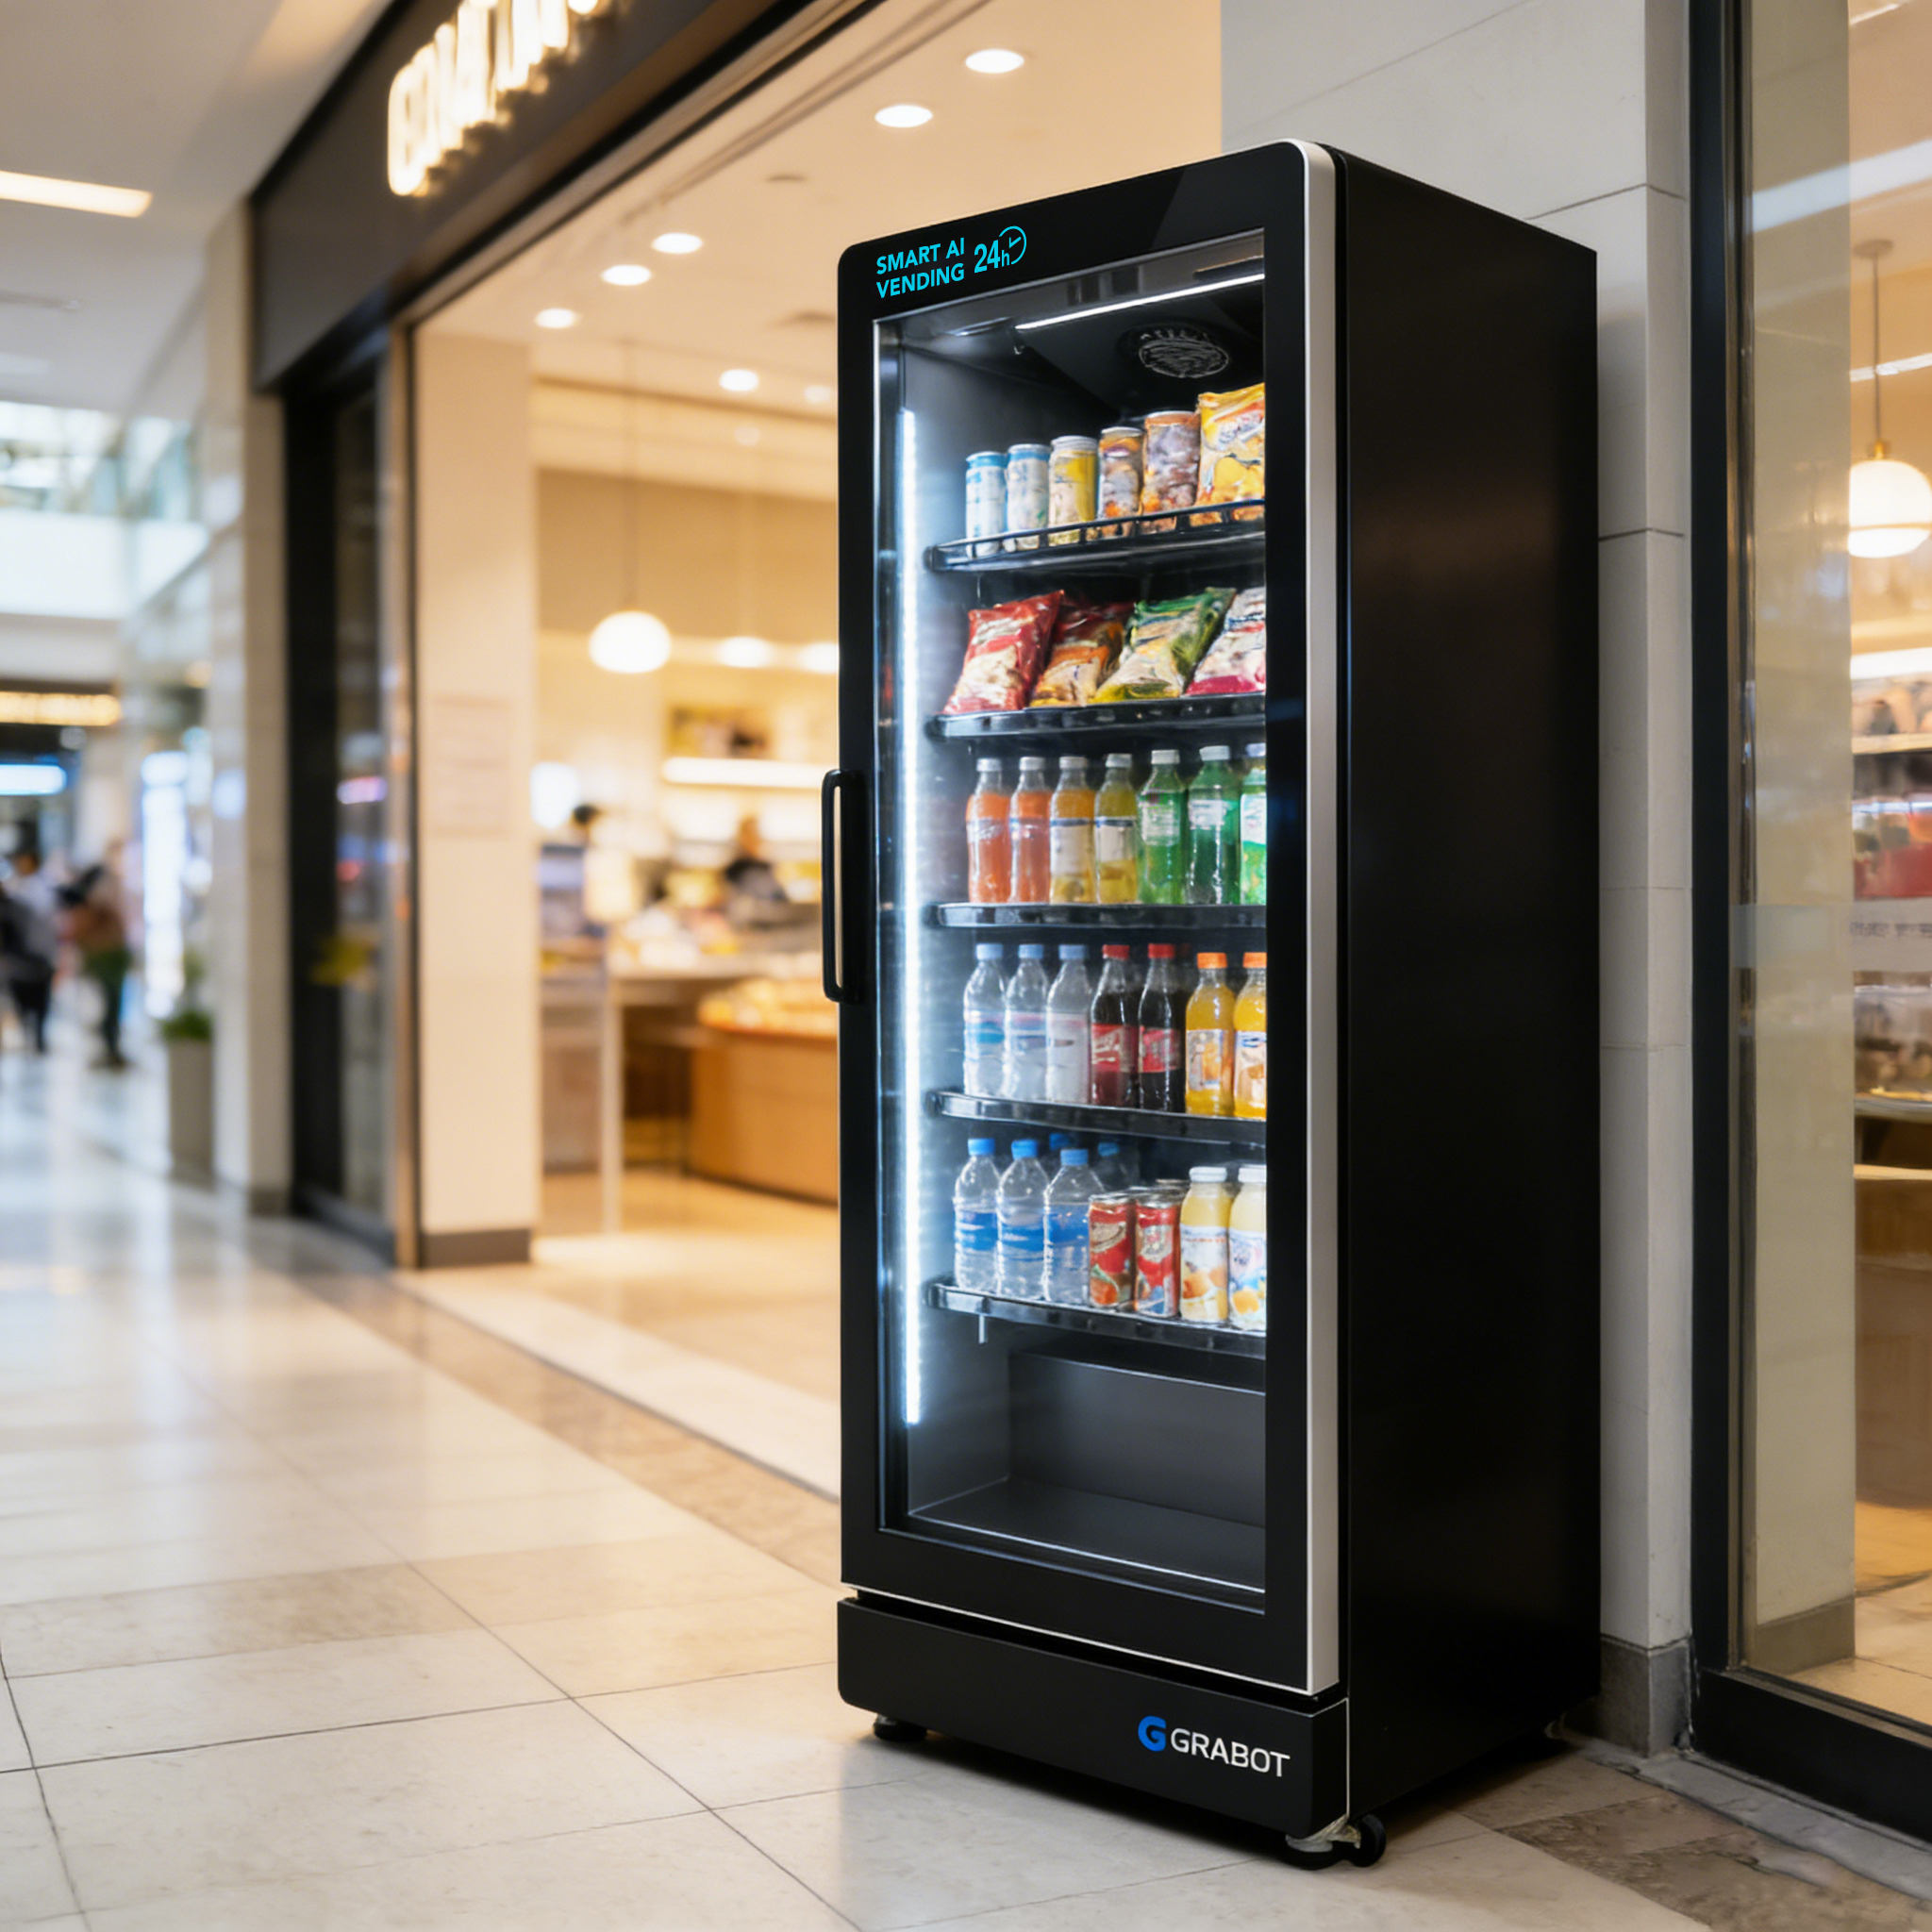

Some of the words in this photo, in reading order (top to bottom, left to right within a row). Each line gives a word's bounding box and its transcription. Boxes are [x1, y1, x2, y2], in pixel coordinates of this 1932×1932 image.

[876, 242, 941, 275] SMART
[945, 237, 965, 259] AI
[876, 262, 965, 299] VENDING
[1170, 1727, 1291, 1778] GRABOT
